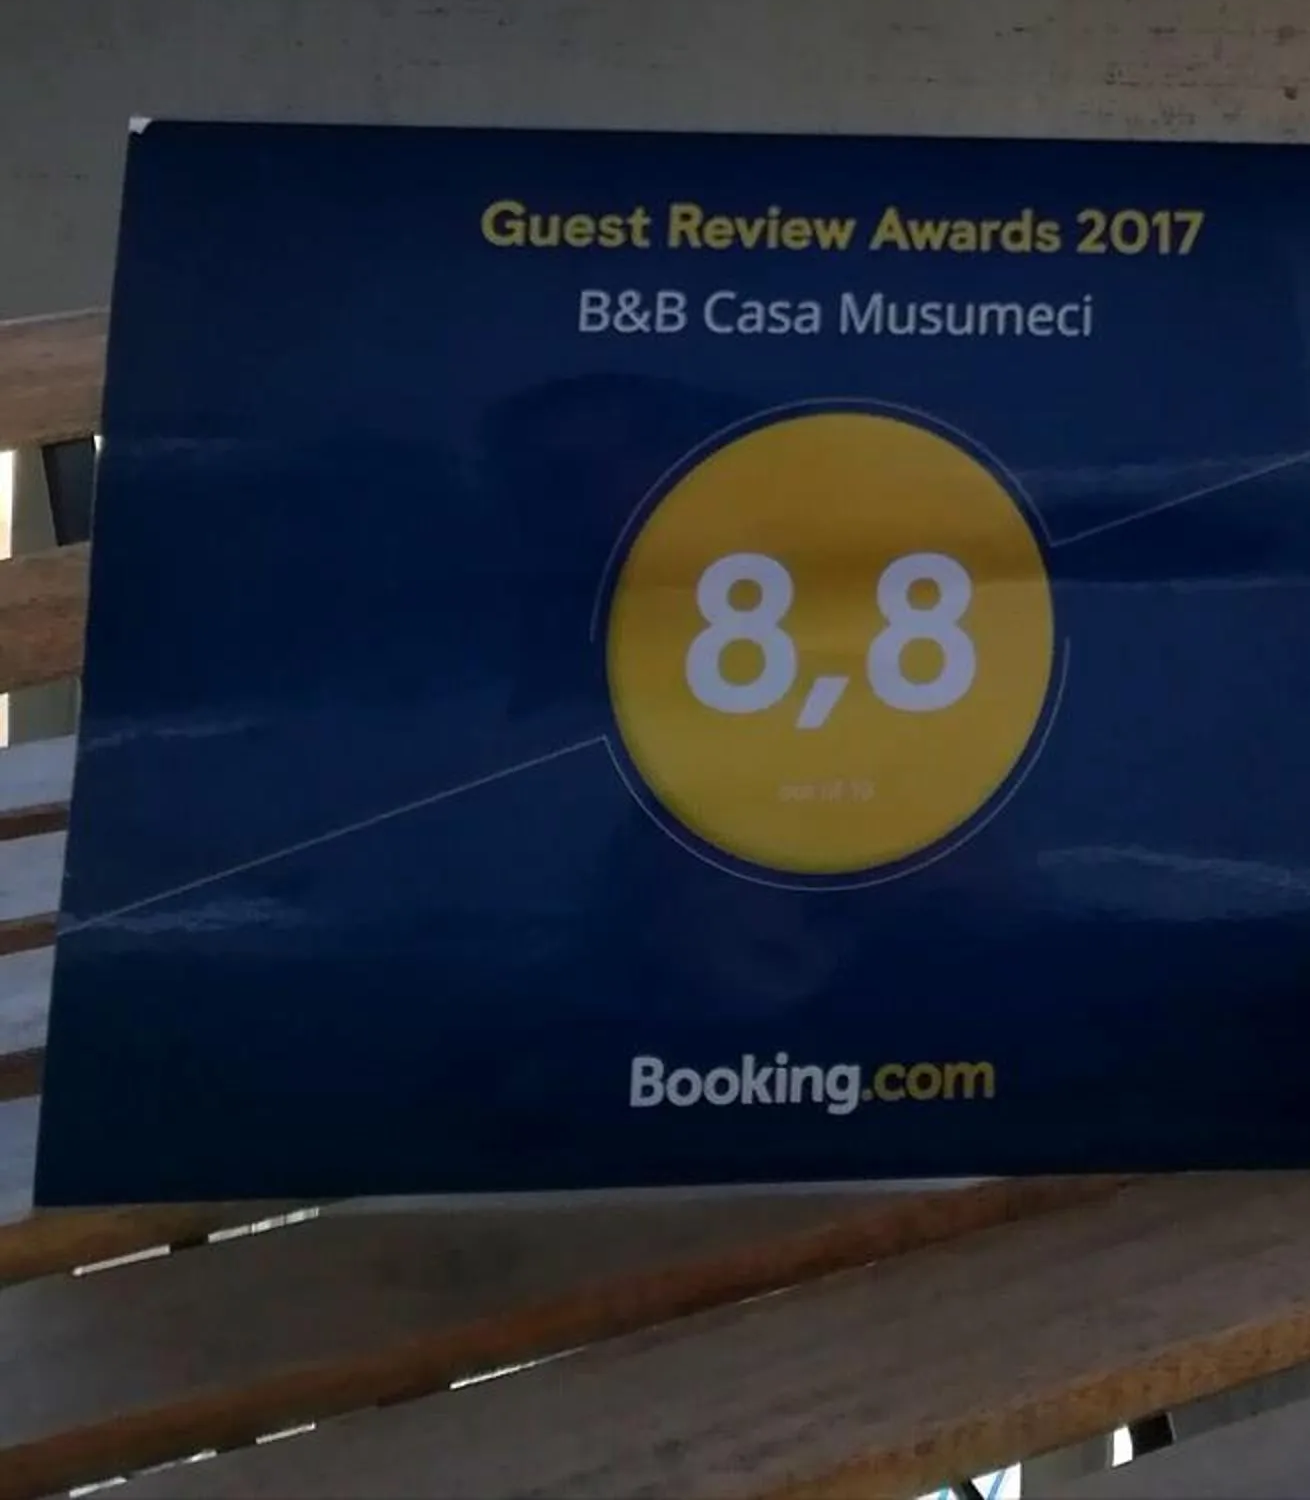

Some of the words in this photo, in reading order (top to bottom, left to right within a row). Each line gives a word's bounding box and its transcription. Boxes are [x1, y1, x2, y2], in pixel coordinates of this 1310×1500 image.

[480, 199, 652, 249] Guest
[667, 202, 857, 251] Review
[868, 206, 1062, 254] Awards
[1075, 207, 1206, 256] 2017
[577, 289, 688, 334] B&B
[702, 290, 822, 335] Casa
[838, 292, 1093, 337] Musumeci
[684, 551, 977, 730] 8,8
[629, 1051, 995, 1116] Booking.com
